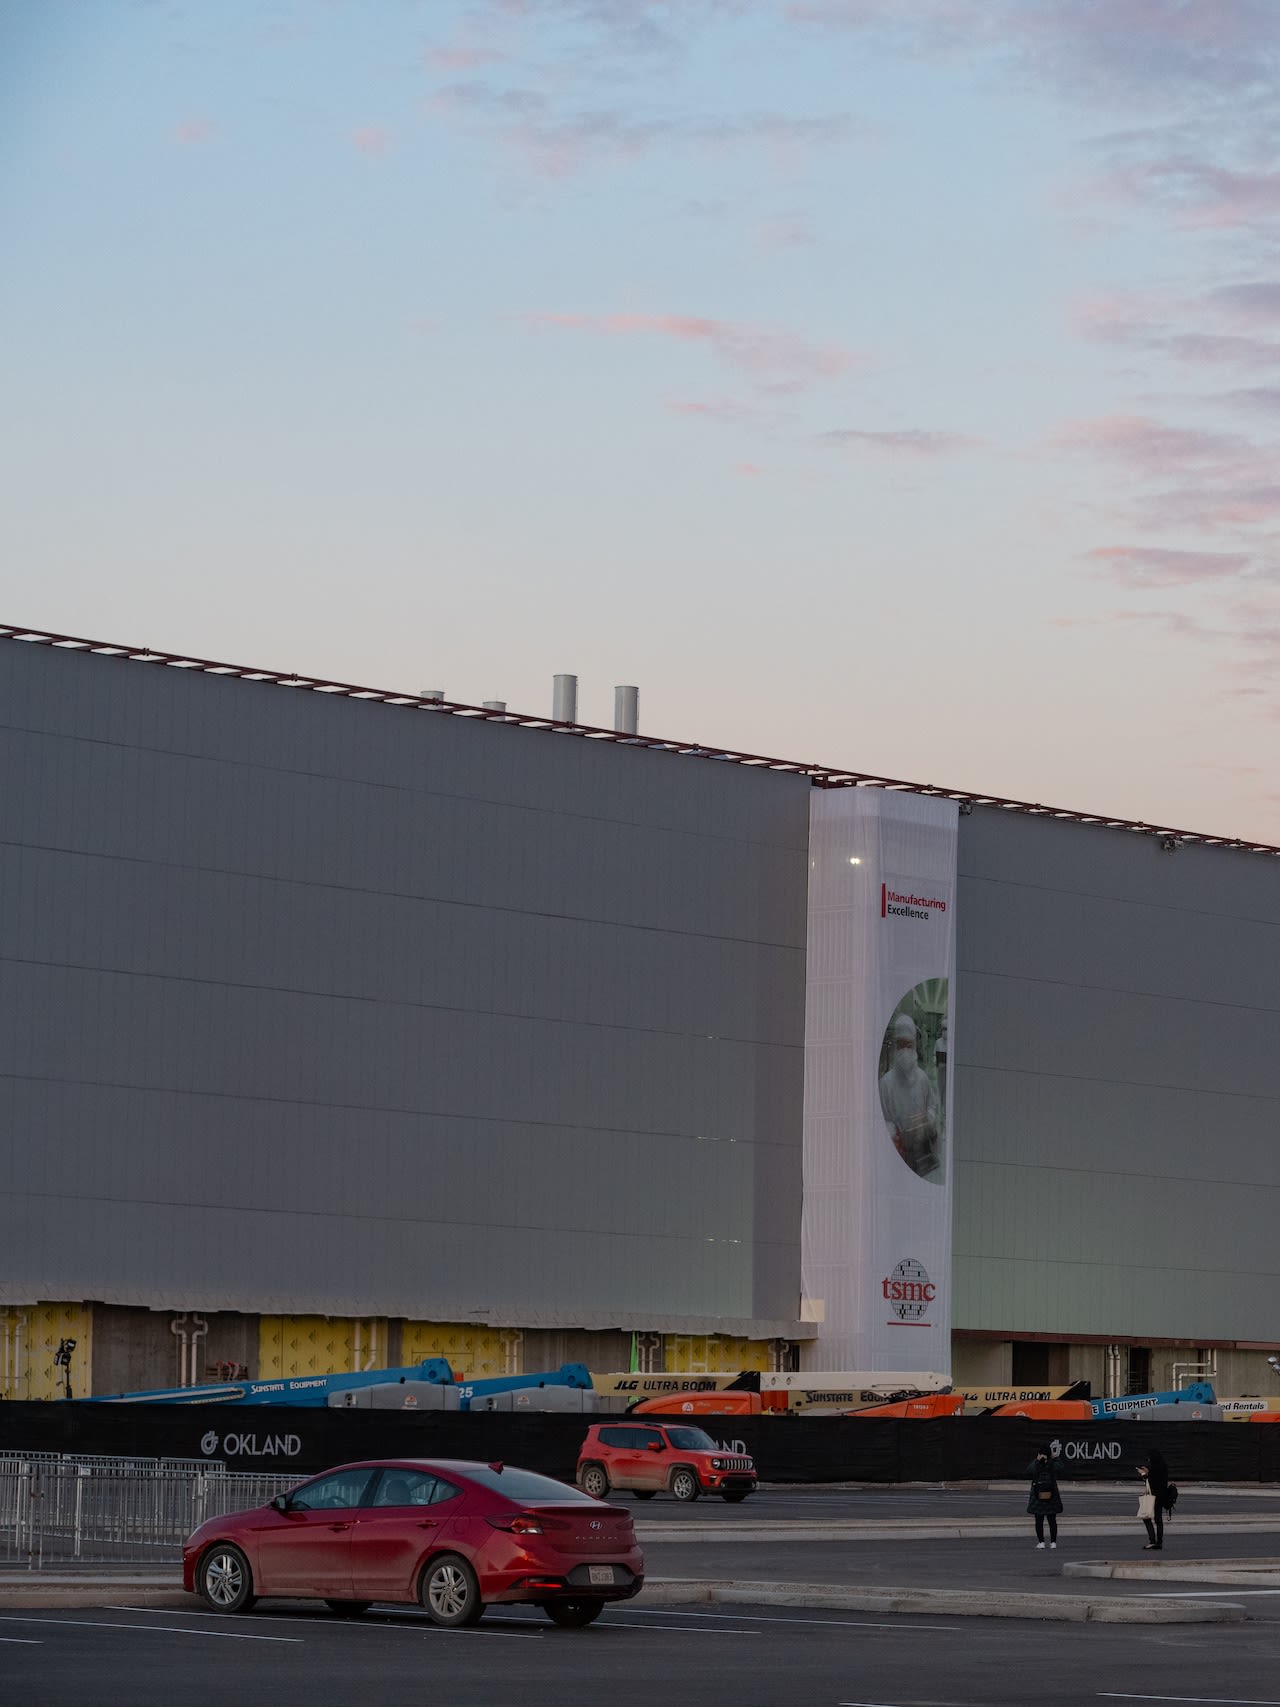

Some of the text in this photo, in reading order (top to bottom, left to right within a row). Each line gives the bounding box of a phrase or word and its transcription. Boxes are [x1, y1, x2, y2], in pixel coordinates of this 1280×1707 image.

[888, 891, 946, 912] Manufacturing
[888, 904, 929, 920] Excellence
[882, 1277, 936, 1302] tsmc
[614, 1380, 717, 1391] JLG ULTRA BOOM
[985, 1391, 1017, 1401] ULTRA
[1019, 1391, 1051, 1401] BOOM
[1105, 1398, 1157, 1412] EQUIPMENT
[1233, 1402, 1265, 1410] Rentals
[223, 1432, 302, 1456] OKLAND
[1065, 1441, 1122, 1460] OKLAND
